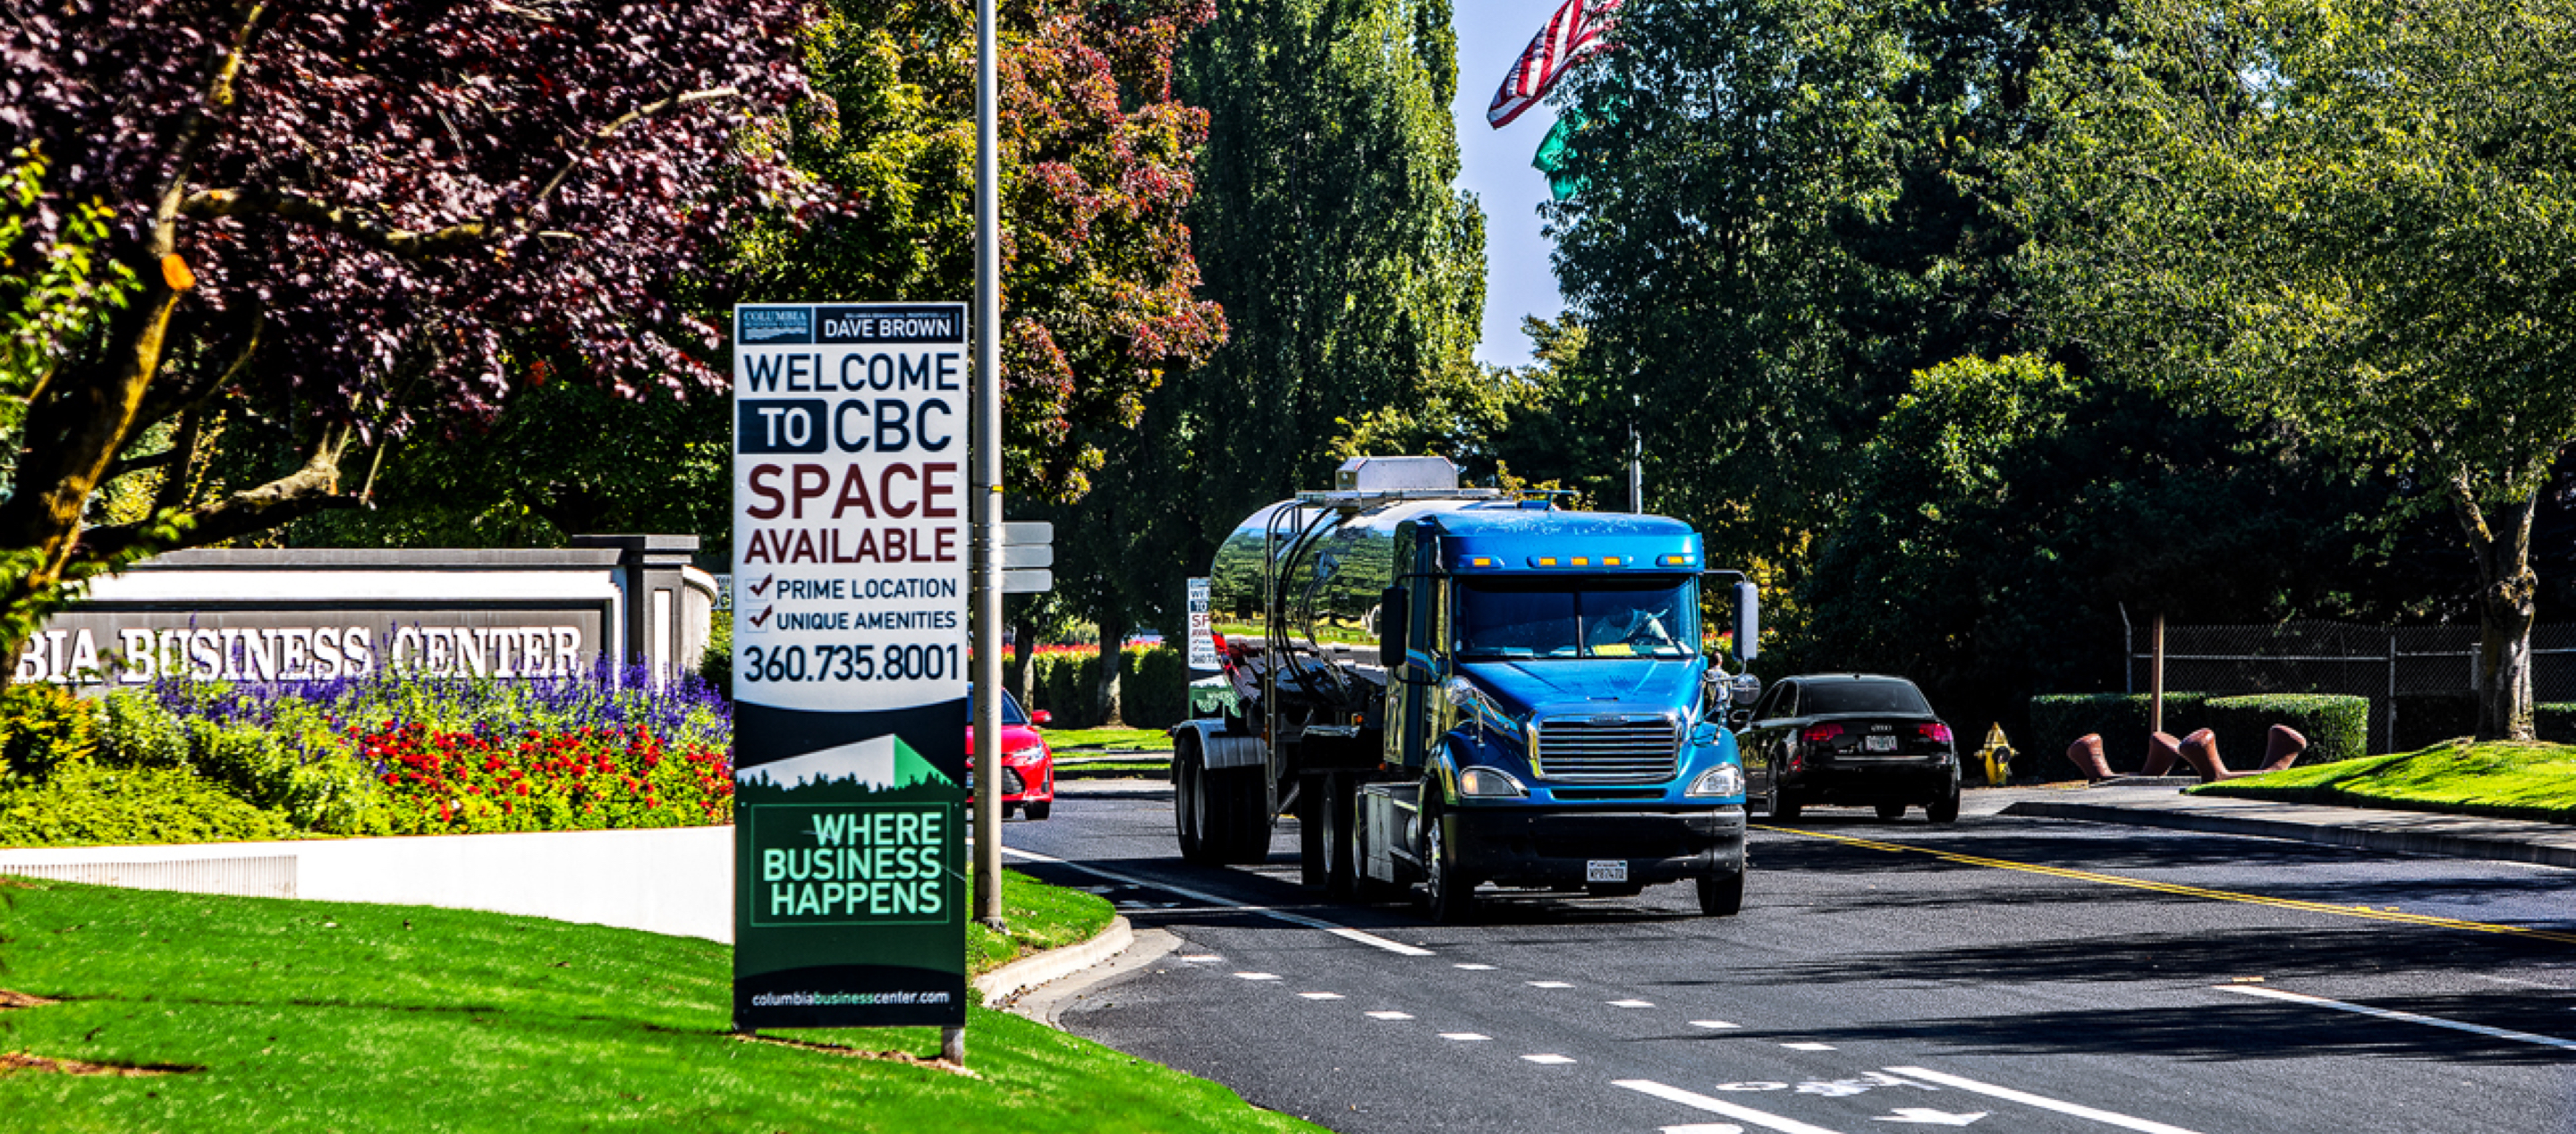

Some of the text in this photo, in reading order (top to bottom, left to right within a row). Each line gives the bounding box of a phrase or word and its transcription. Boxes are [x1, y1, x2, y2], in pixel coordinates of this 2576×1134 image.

[824, 318, 875, 337] DAVE
[879, 318, 951, 337] BROWN
[743, 352, 960, 392] WELCOME
[758, 398, 952, 453] TO CBC
[746, 462, 957, 520] SPACE
[743, 527, 957, 564] AVAILABLE
[776, 578, 956, 599] PRIME LOCATION
[776, 611, 957, 630] UNIQUE AMENITIES
[117, 627, 374, 684] BUSINESS
[389, 626, 583, 681] CENTER
[743, 643, 958, 682] 360.735.8001
[811, 812, 943, 846] WHERE
[763, 846, 943, 882] BUSINESS
[771, 881, 942, 916] HAPPENS
[752, 990, 951, 1006] columbiabusinesscenter.com
